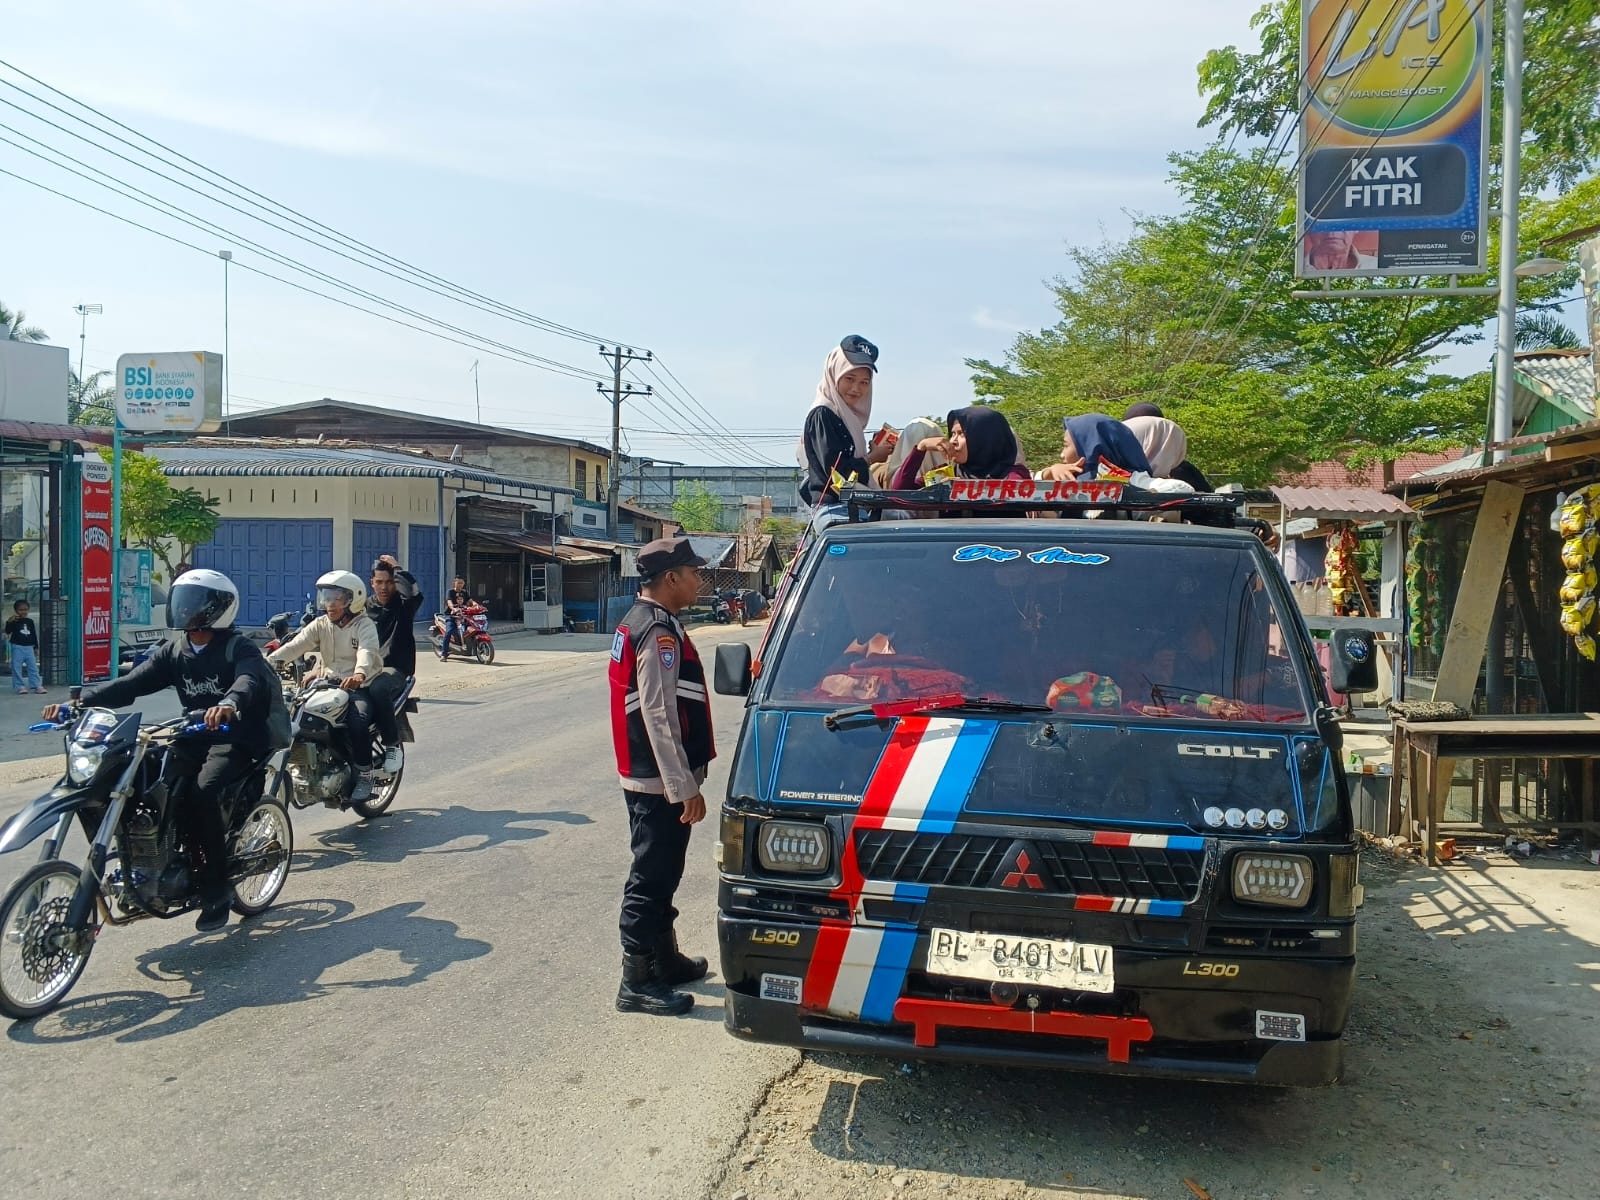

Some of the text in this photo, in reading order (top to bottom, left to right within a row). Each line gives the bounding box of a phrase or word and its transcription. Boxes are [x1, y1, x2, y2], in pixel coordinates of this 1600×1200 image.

[1401, 56, 1443, 70] ICE
[1349, 86, 1448, 100] MANGOBOOST
[1350, 156, 1419, 181] KAK
[1345, 182, 1422, 208] FITRI
[125, 367, 152, 386] BSI
[86, 472, 107, 480] PONSEL
[950, 480, 1123, 503] PUTRO JOWO
[90, 617, 110, 635] KUAT
[1177, 743, 1281, 761] COLT
[780, 790, 815, 799] POWER
[751, 928, 801, 946] L300
[937, 932, 1108, 974] BL 8461 LV
[1182, 961, 1240, 977] L300
